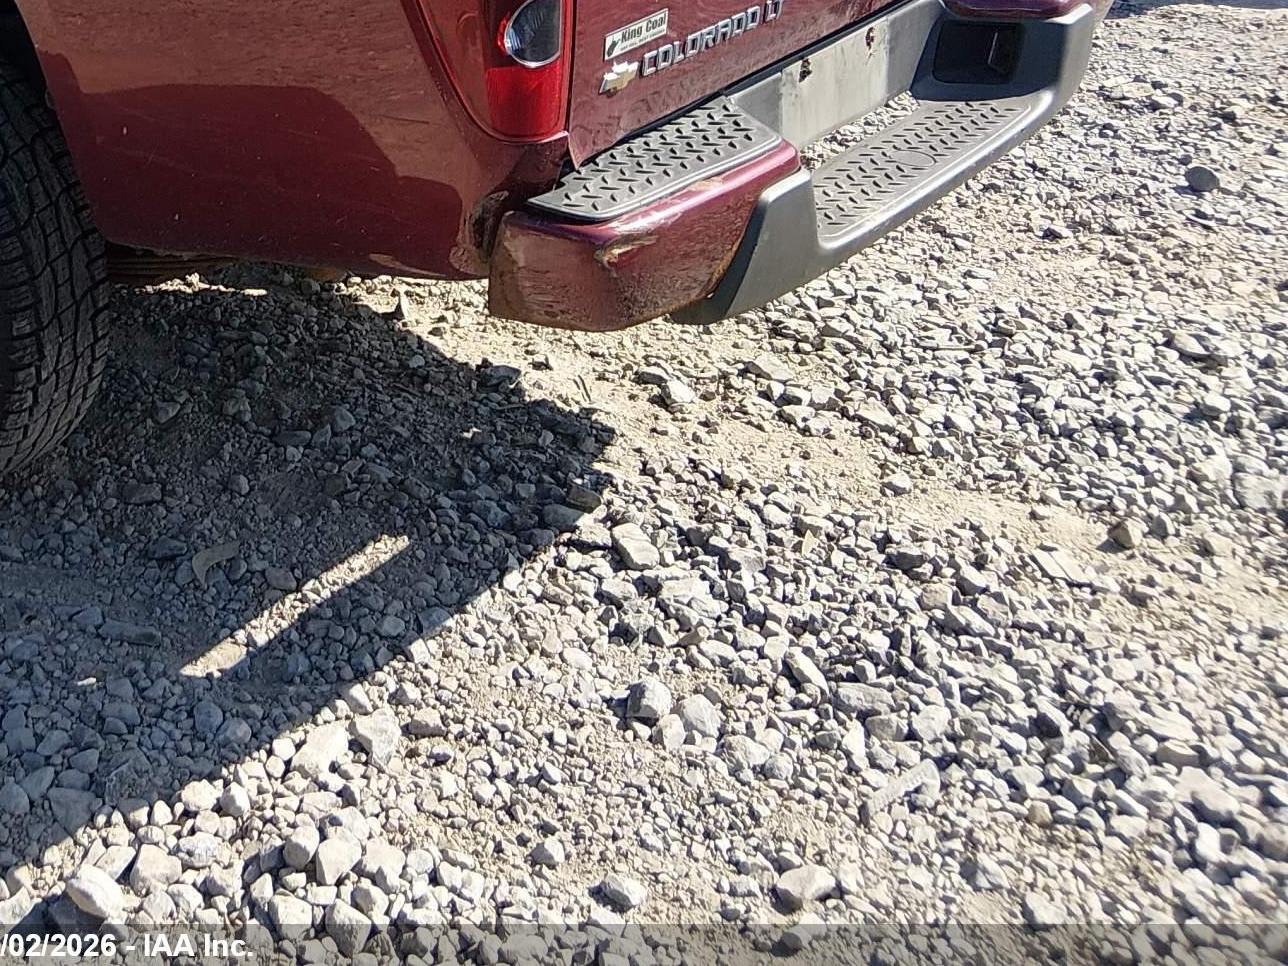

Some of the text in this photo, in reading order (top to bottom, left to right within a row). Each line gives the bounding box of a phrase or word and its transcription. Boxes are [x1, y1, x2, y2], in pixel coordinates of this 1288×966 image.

[621, 25, 643, 43] King
[645, 12, 667, 33] Coal
[642, 5, 761, 76] COLORADO
